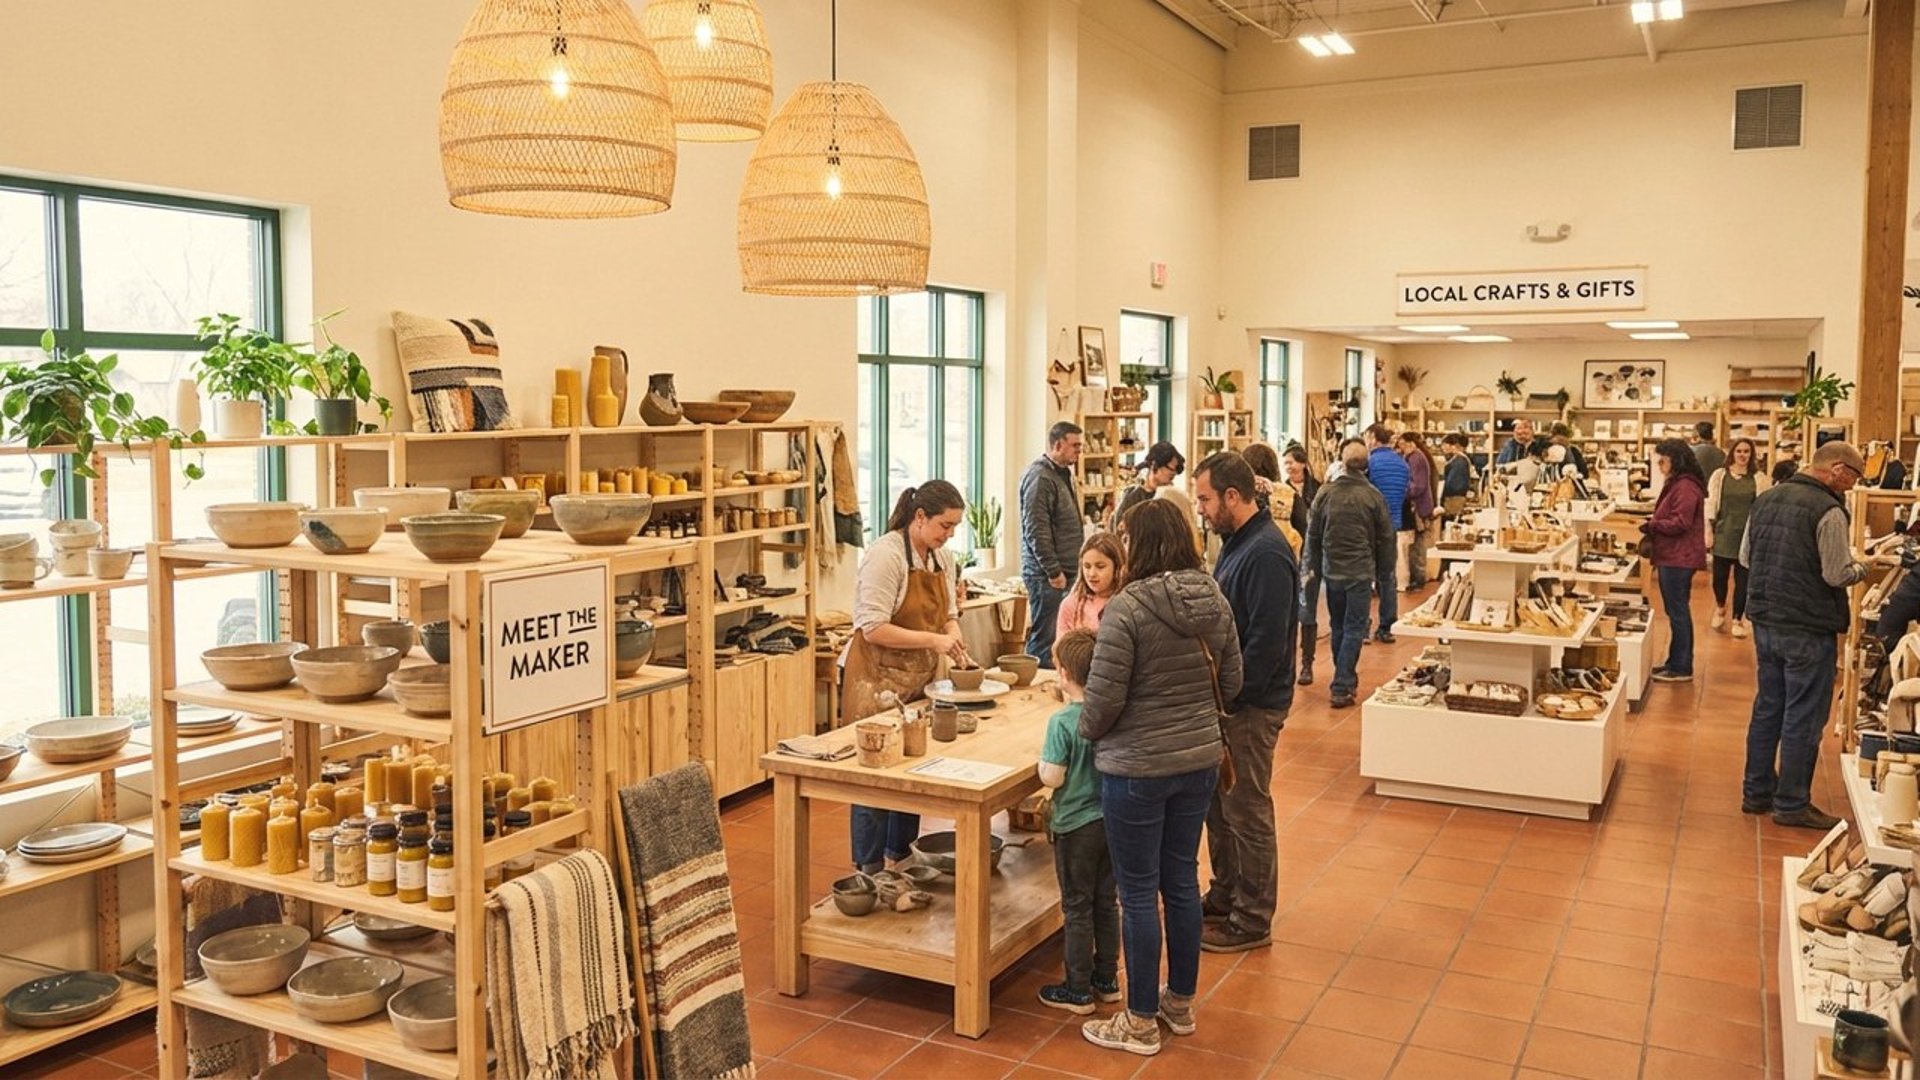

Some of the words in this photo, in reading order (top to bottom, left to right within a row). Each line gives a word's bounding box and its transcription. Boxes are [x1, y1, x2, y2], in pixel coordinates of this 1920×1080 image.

[1404, 286, 1468, 302] LOCAL
[1473, 283, 1550, 301] CRAFTS
[1556, 283, 1570, 298] &
[1576, 280, 1636, 298] GIFTS
[501, 613, 562, 647] MEET
[567, 606, 597, 627] THE
[509, 640, 590, 680] MAKER
